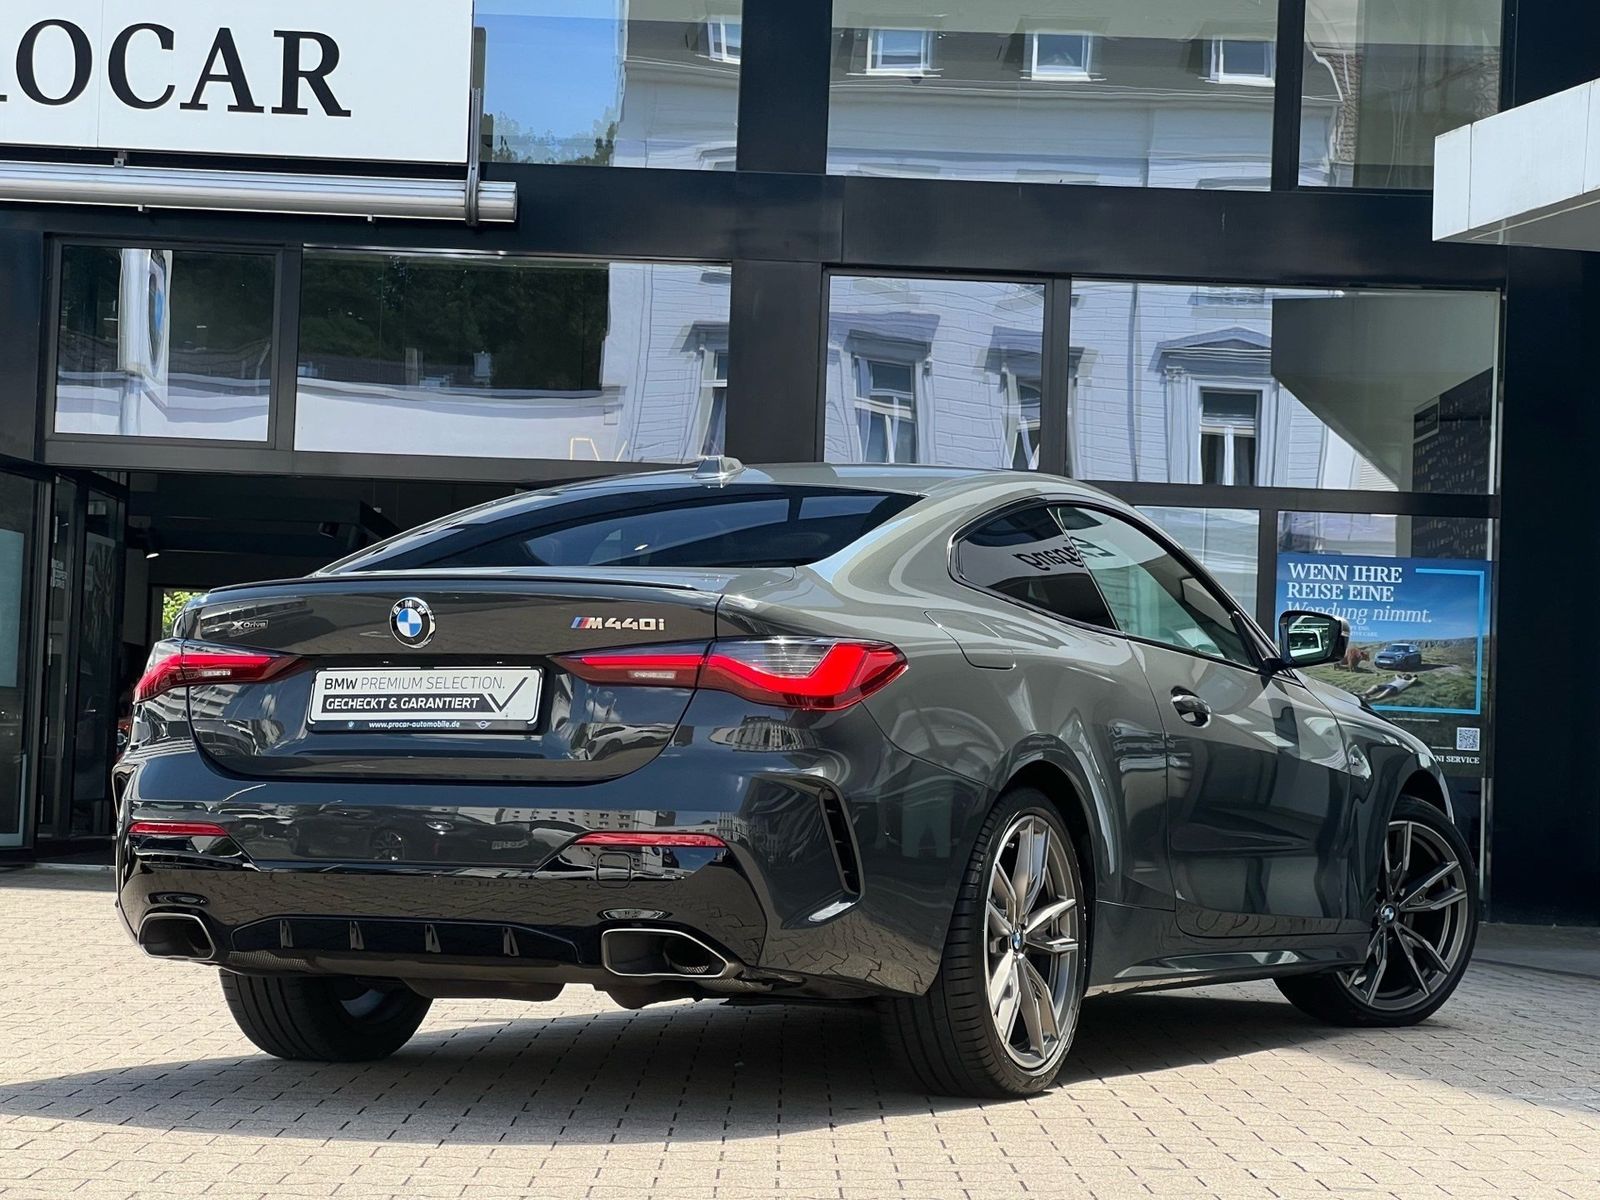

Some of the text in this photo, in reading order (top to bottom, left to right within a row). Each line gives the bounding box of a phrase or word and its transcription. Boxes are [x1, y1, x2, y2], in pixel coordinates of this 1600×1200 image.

[0, 19, 351, 117] OCAR
[1288, 562, 1402, 583] WENN IHRE
[1287, 582, 1394, 602] REISE EINE
[1373, 605, 1432, 623] nimmt.
[586, 616, 665, 631] M440i
[324, 676, 505, 690] BMW PREMIUM SELECTION.
[325, 697, 480, 710] GECHECKT & GARANTIERT
[368, 720, 461, 730] www.procar-automobile.de
[1446, 755, 1480, 764] SERVICE
